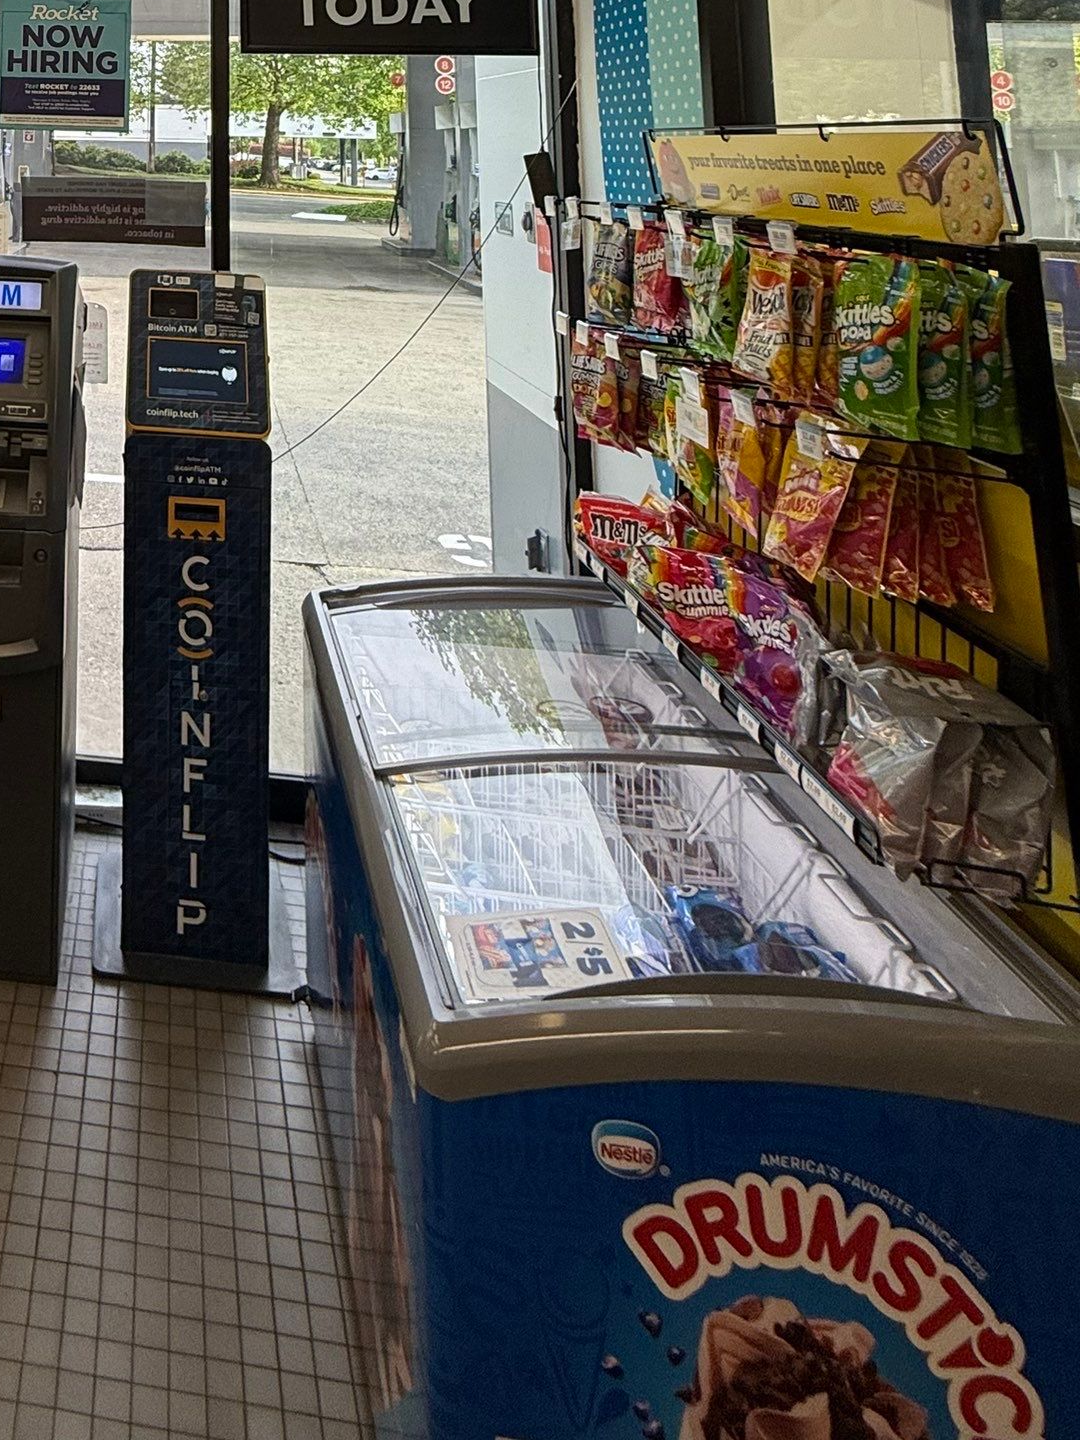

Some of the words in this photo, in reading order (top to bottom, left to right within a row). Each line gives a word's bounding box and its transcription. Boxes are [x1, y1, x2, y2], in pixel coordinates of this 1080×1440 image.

[29, 3, 100, 21] Rocket
[22, 24, 105, 49] NOW
[7, 49, 119, 75] HIRING
[441, 60, 449, 70] 8
[439, 79, 451, 89] 12
[996, 77, 1006, 85] 4
[997, 97, 1010, 105] 10
[687, 155, 711, 170] your
[710, 153, 755, 170] favorite
[755, 154, 797, 172] treats
[796, 154, 813, 171] in
[813, 158, 840, 173] one
[843, 155, 886, 178] place
[870, 197, 906, 215] Skittles
[147, 323, 177, 333] Bitcoin
[178, 324, 198, 334] ATM
[146, 407, 199, 420] coinflip.tech
[675, 604, 731, 618] Gummie
[177, 555, 213, 935] COINFLIP
[600, 1142, 654, 1166] Nestlé
[759, 1153, 842, 1181] AMERICA'S
[843, 1171, 914, 1218] FAVORITE
[914, 1211, 960, 1253] SINCE
[632, 1182, 1033, 1440] DRUMSTIC
